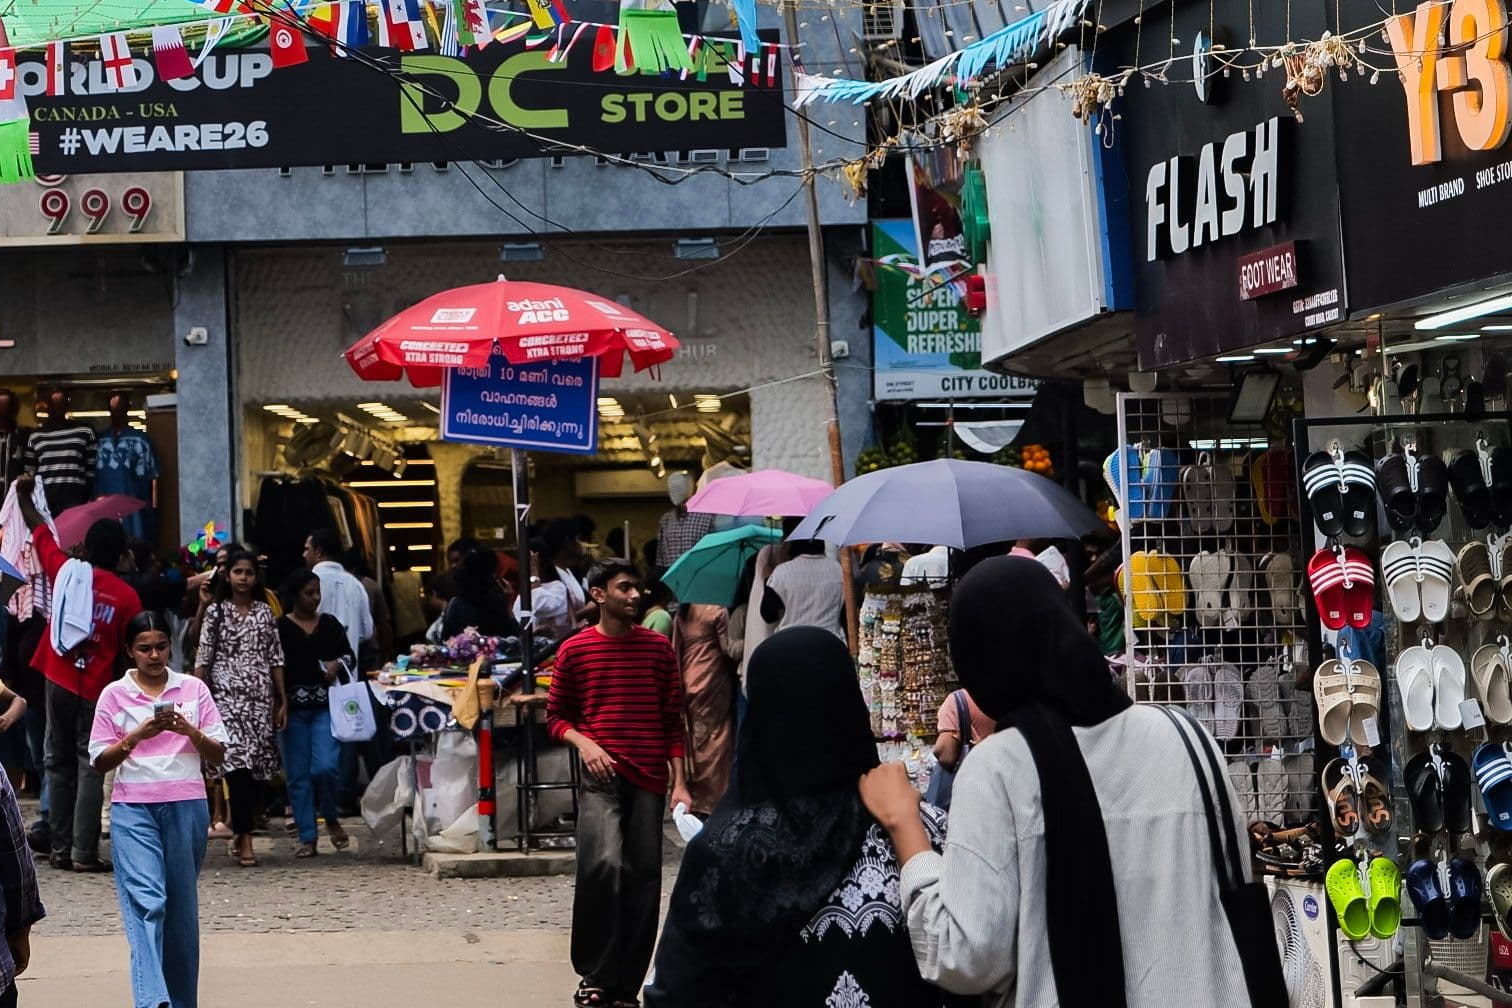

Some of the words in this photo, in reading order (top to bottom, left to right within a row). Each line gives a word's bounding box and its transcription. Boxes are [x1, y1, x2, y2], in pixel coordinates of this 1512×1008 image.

[400, 51, 569, 134] DC
[601, 91, 745, 123] STORE
[34, 103, 120, 122] CANADA
[139, 101, 179, 118] USA
[59, 120, 269, 156] #WEARE26
[1145, 115, 1279, 263] FLASH
[1418, 187, 1438, 209] MULTI
[1439, 177, 1465, 202] BRAND
[1476, 168, 1496, 190] SHOE
[39, 187, 153, 236] 999
[1241, 261, 1264, 291] FOOT
[1265, 252, 1294, 282] WEAR
[506, 297, 565, 311] adani
[518, 308, 569, 325] ACC
[500, 367, 515, 381] 10
[519, 369, 549, 385] മണി
[551, 373, 584, 388] വരെ
[941, 376, 974, 392] CITY
[979, 375, 1039, 392] COOLBA
